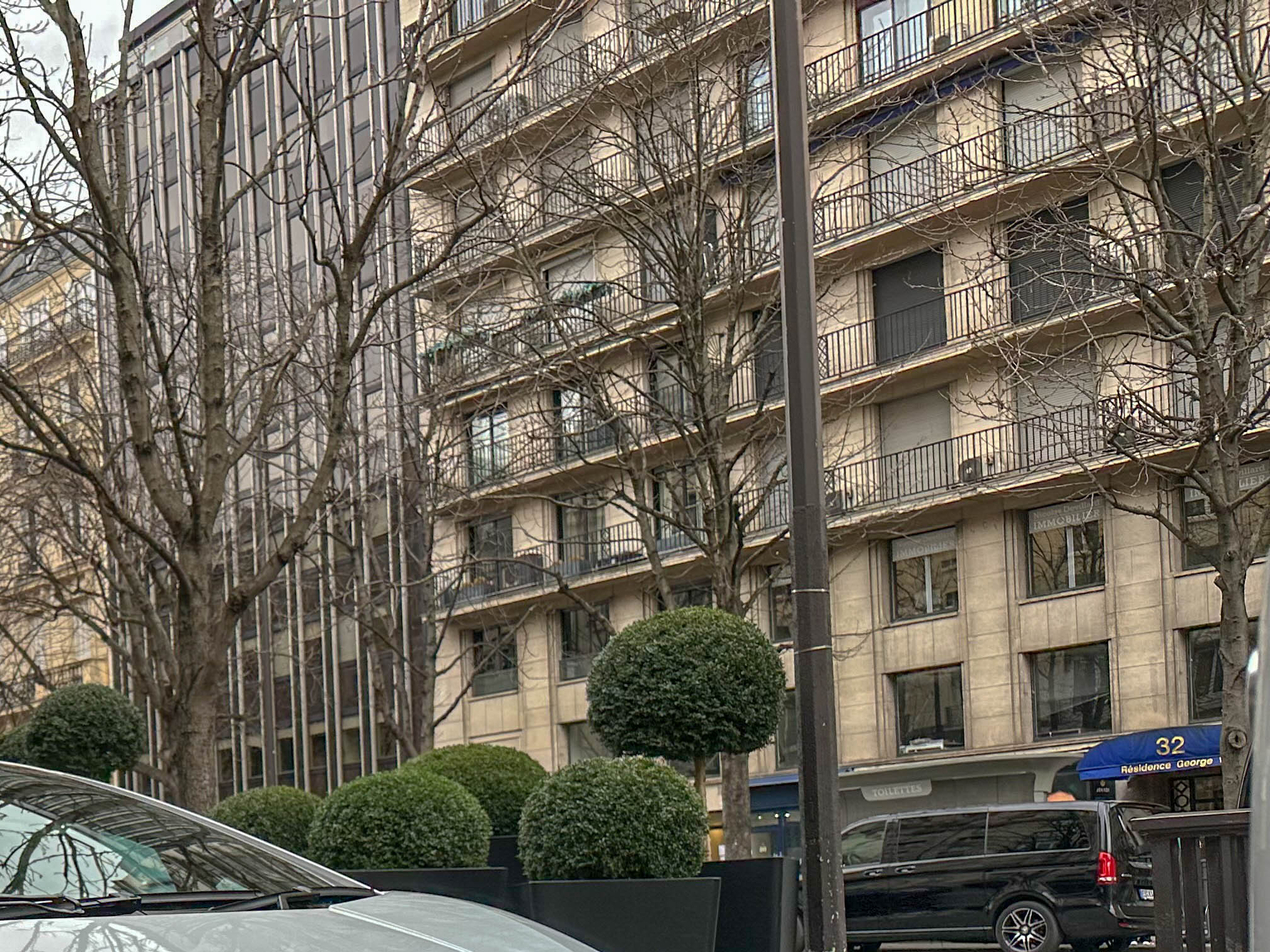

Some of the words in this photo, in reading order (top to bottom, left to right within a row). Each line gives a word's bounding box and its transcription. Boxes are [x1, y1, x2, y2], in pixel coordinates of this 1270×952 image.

[1156, 736, 1185, 756] 32
[1121, 762, 1171, 774] Résidence
[1177, 757, 1213, 768] George
[872, 785, 923, 797] TOILETTES
